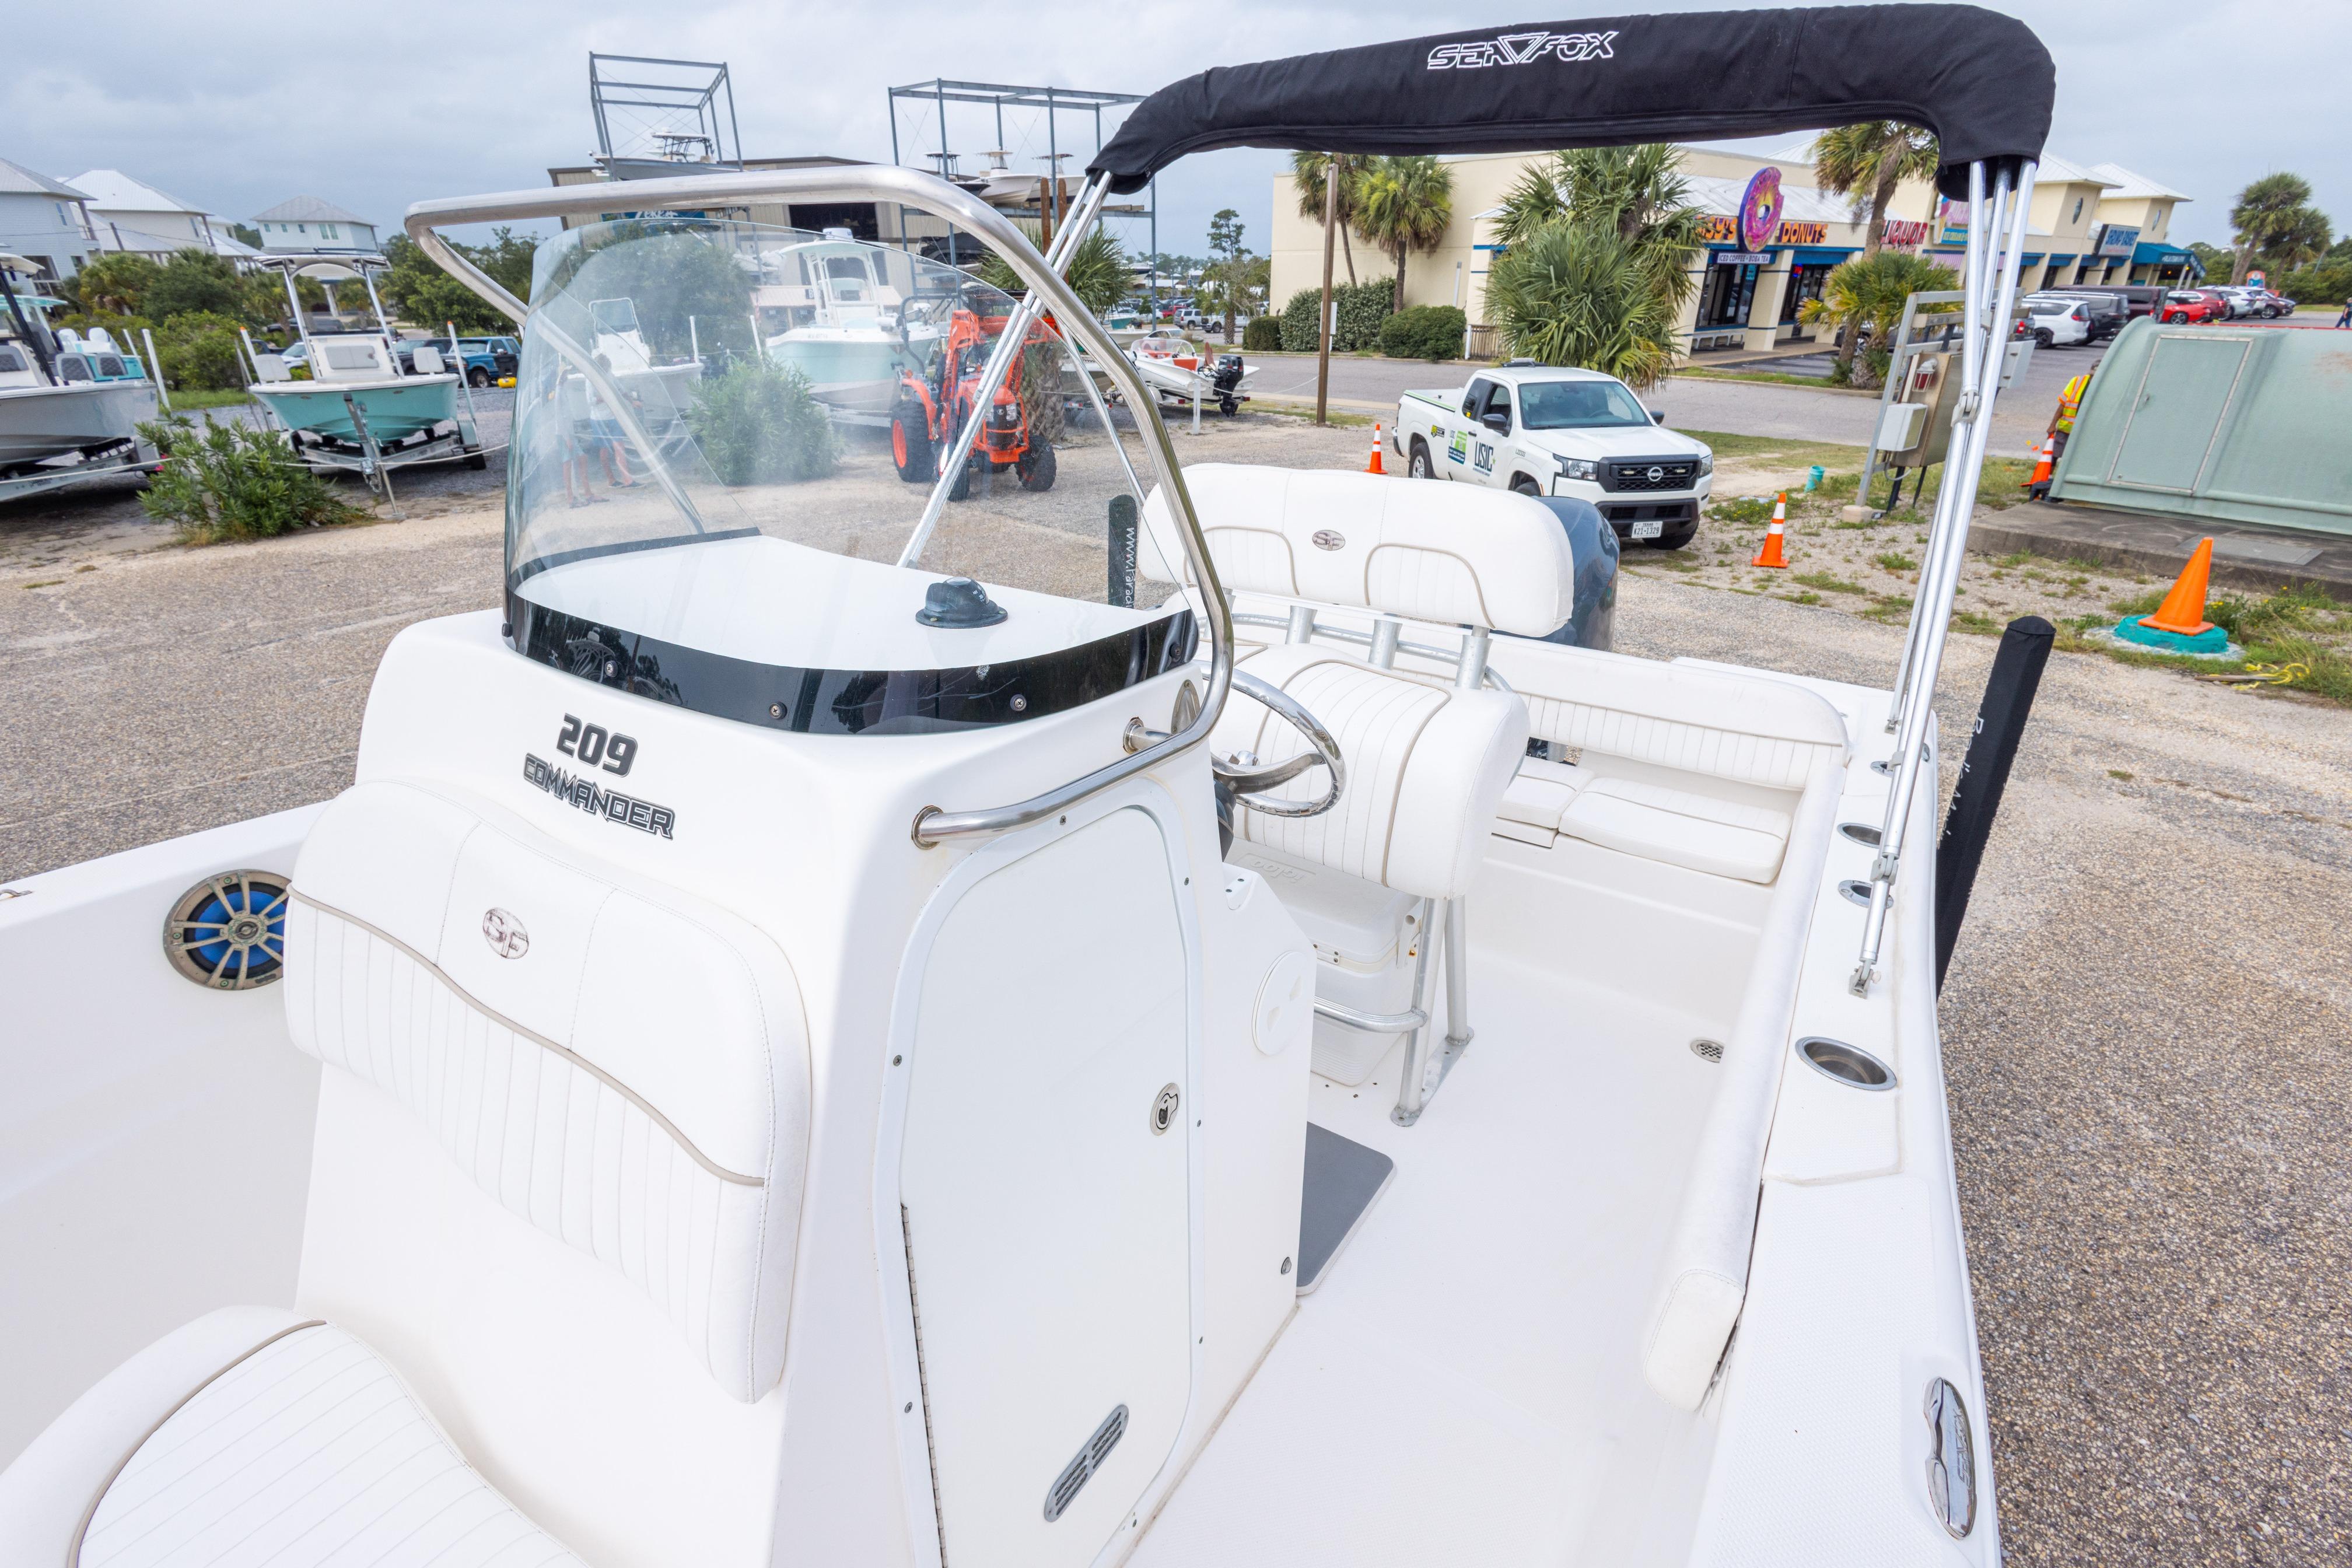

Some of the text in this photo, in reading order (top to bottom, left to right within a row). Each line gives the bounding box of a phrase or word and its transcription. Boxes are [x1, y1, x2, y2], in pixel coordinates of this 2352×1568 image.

[1779, 222, 1828, 243] DONUTS
[1881, 219, 1928, 244] LIQUOR
[1474, 440, 1494, 472] USIC
[556, 712, 638, 778] 209
[523, 752, 676, 841] COMMANDER
